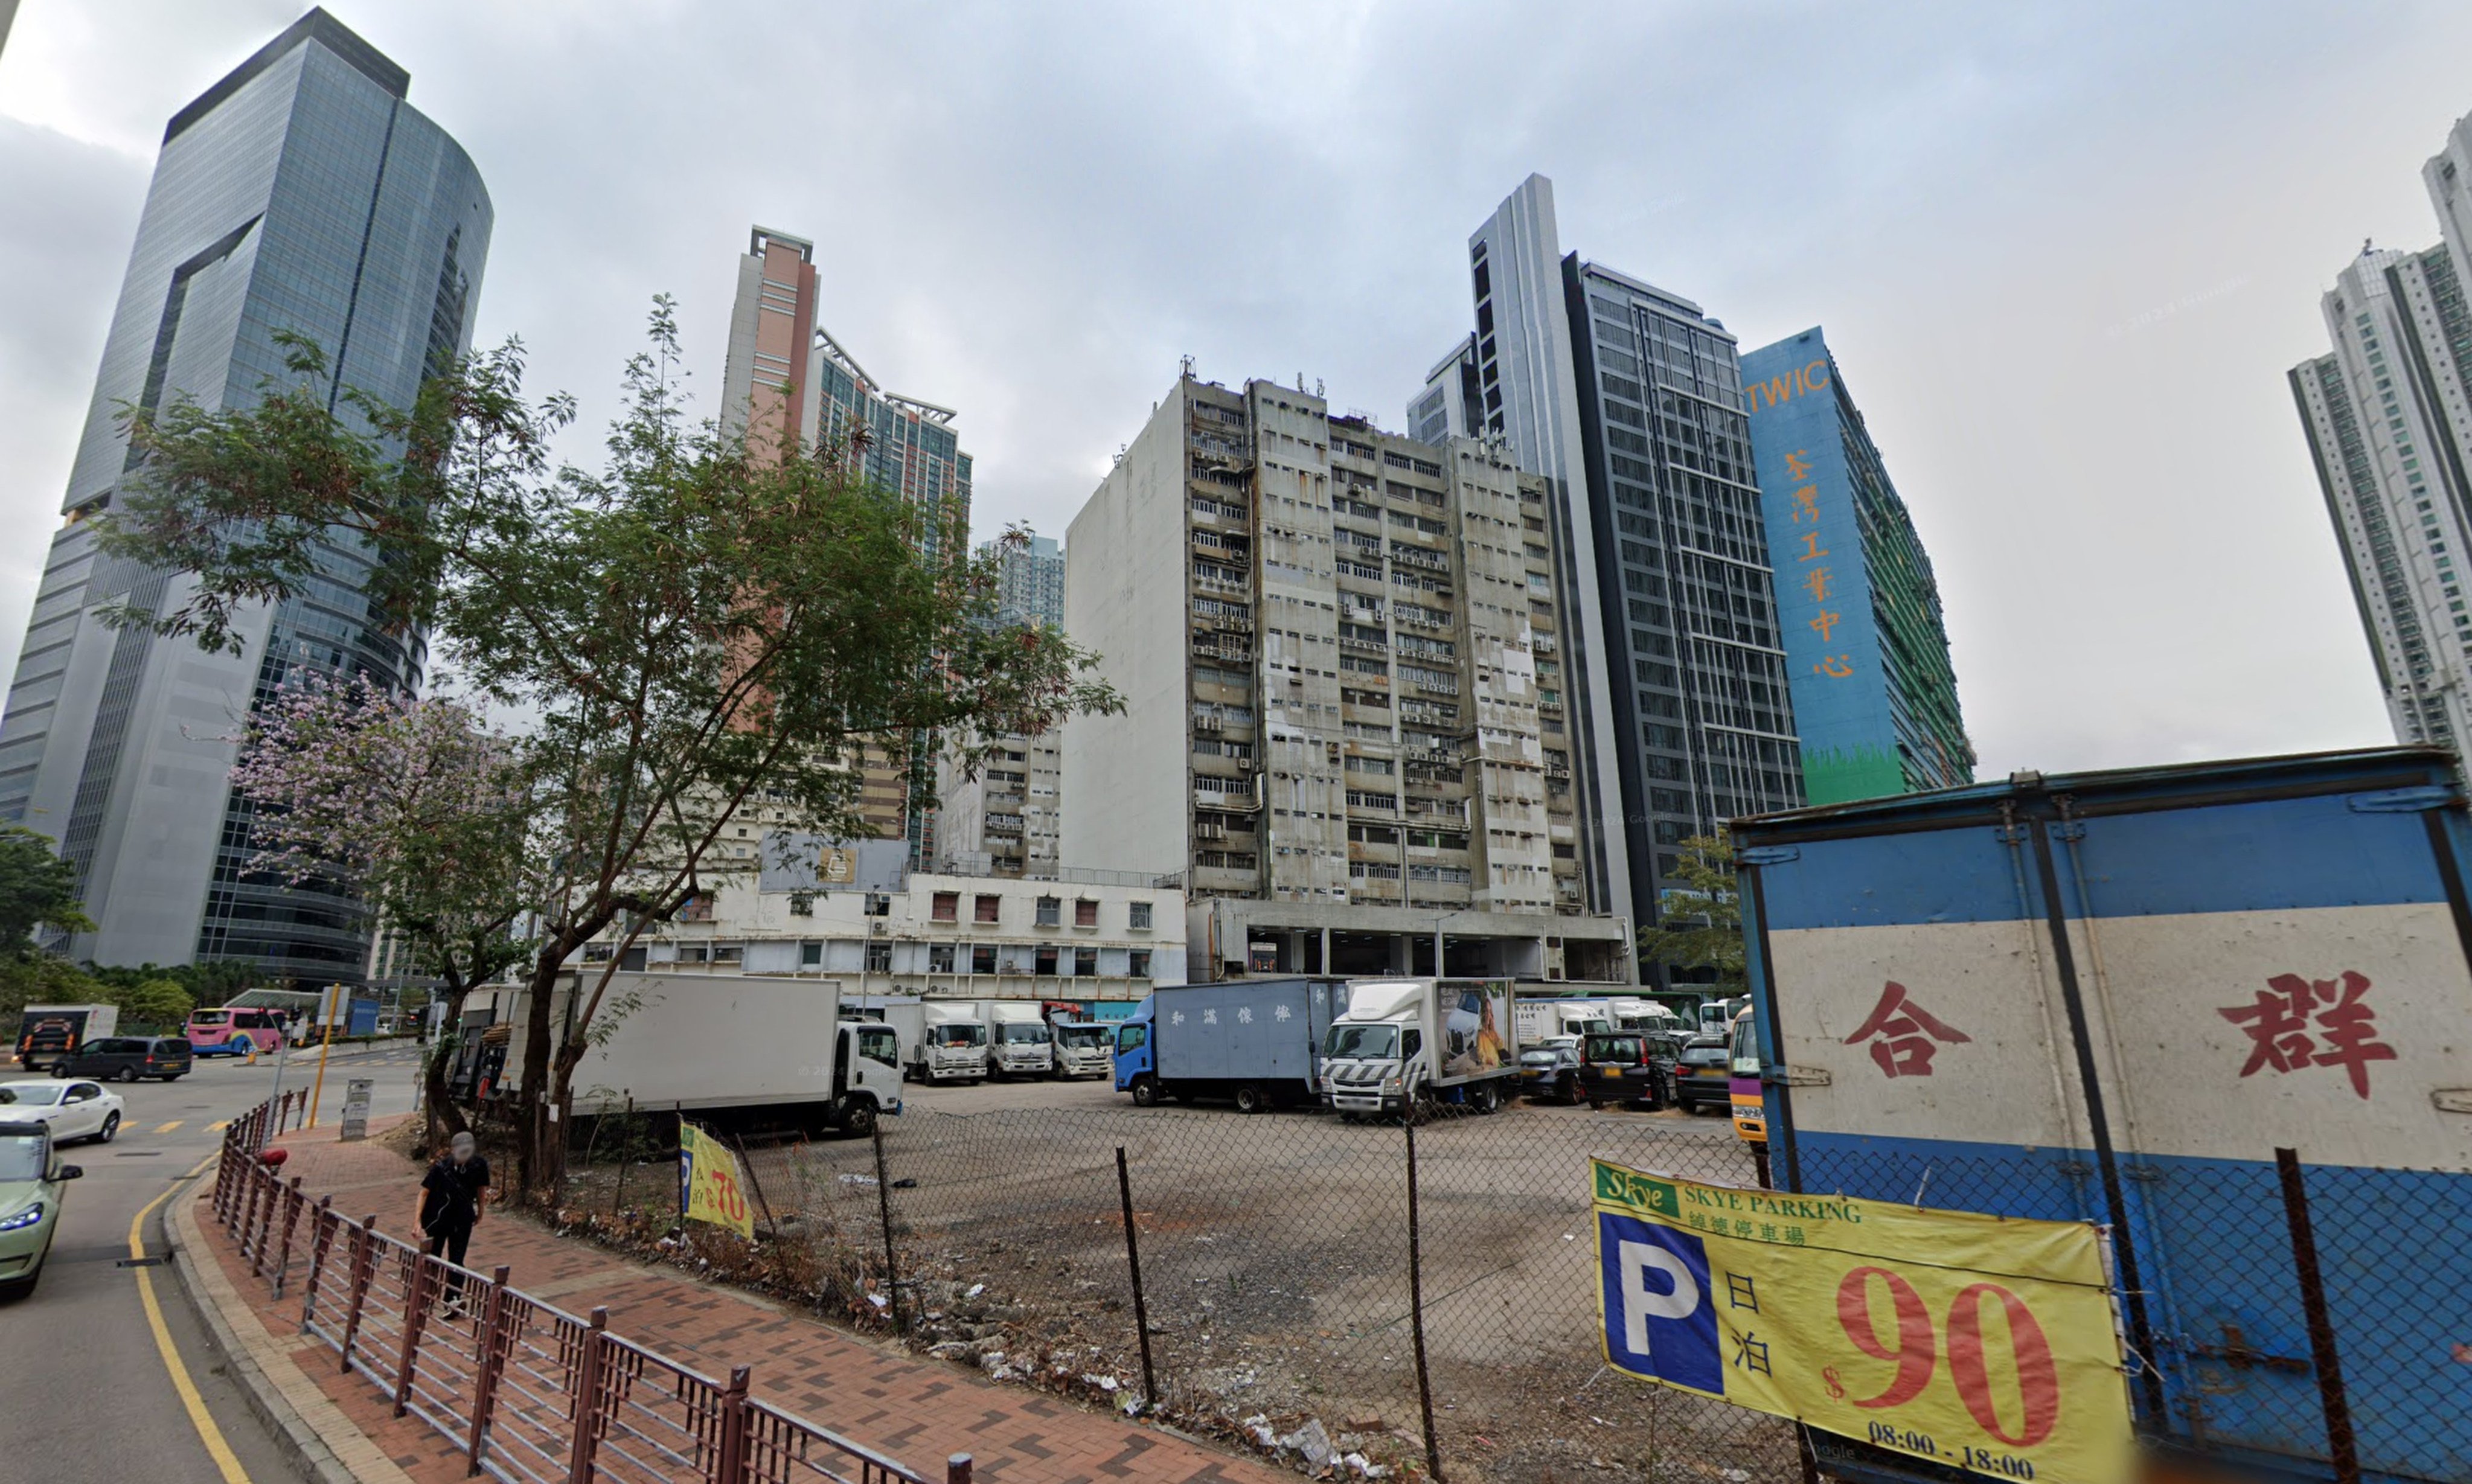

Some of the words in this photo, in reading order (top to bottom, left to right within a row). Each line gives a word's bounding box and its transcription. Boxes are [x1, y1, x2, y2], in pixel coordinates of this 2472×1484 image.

[1745, 360, 1830, 413] TWIC
[1785, 449, 1854, 677] 荃灣工業中心
[1607, 1172, 1663, 1207] Skye
[1685, 1186, 1744, 1211] SKYE
[1751, 1196, 1862, 1224] PARKING
[1619, 1239, 1700, 1356] P
[1725, 1271, 1772, 1378] 日泊
[1868, 1421, 1935, 1457] 08:00
[1962, 1446, 2035, 1481] 18:00
